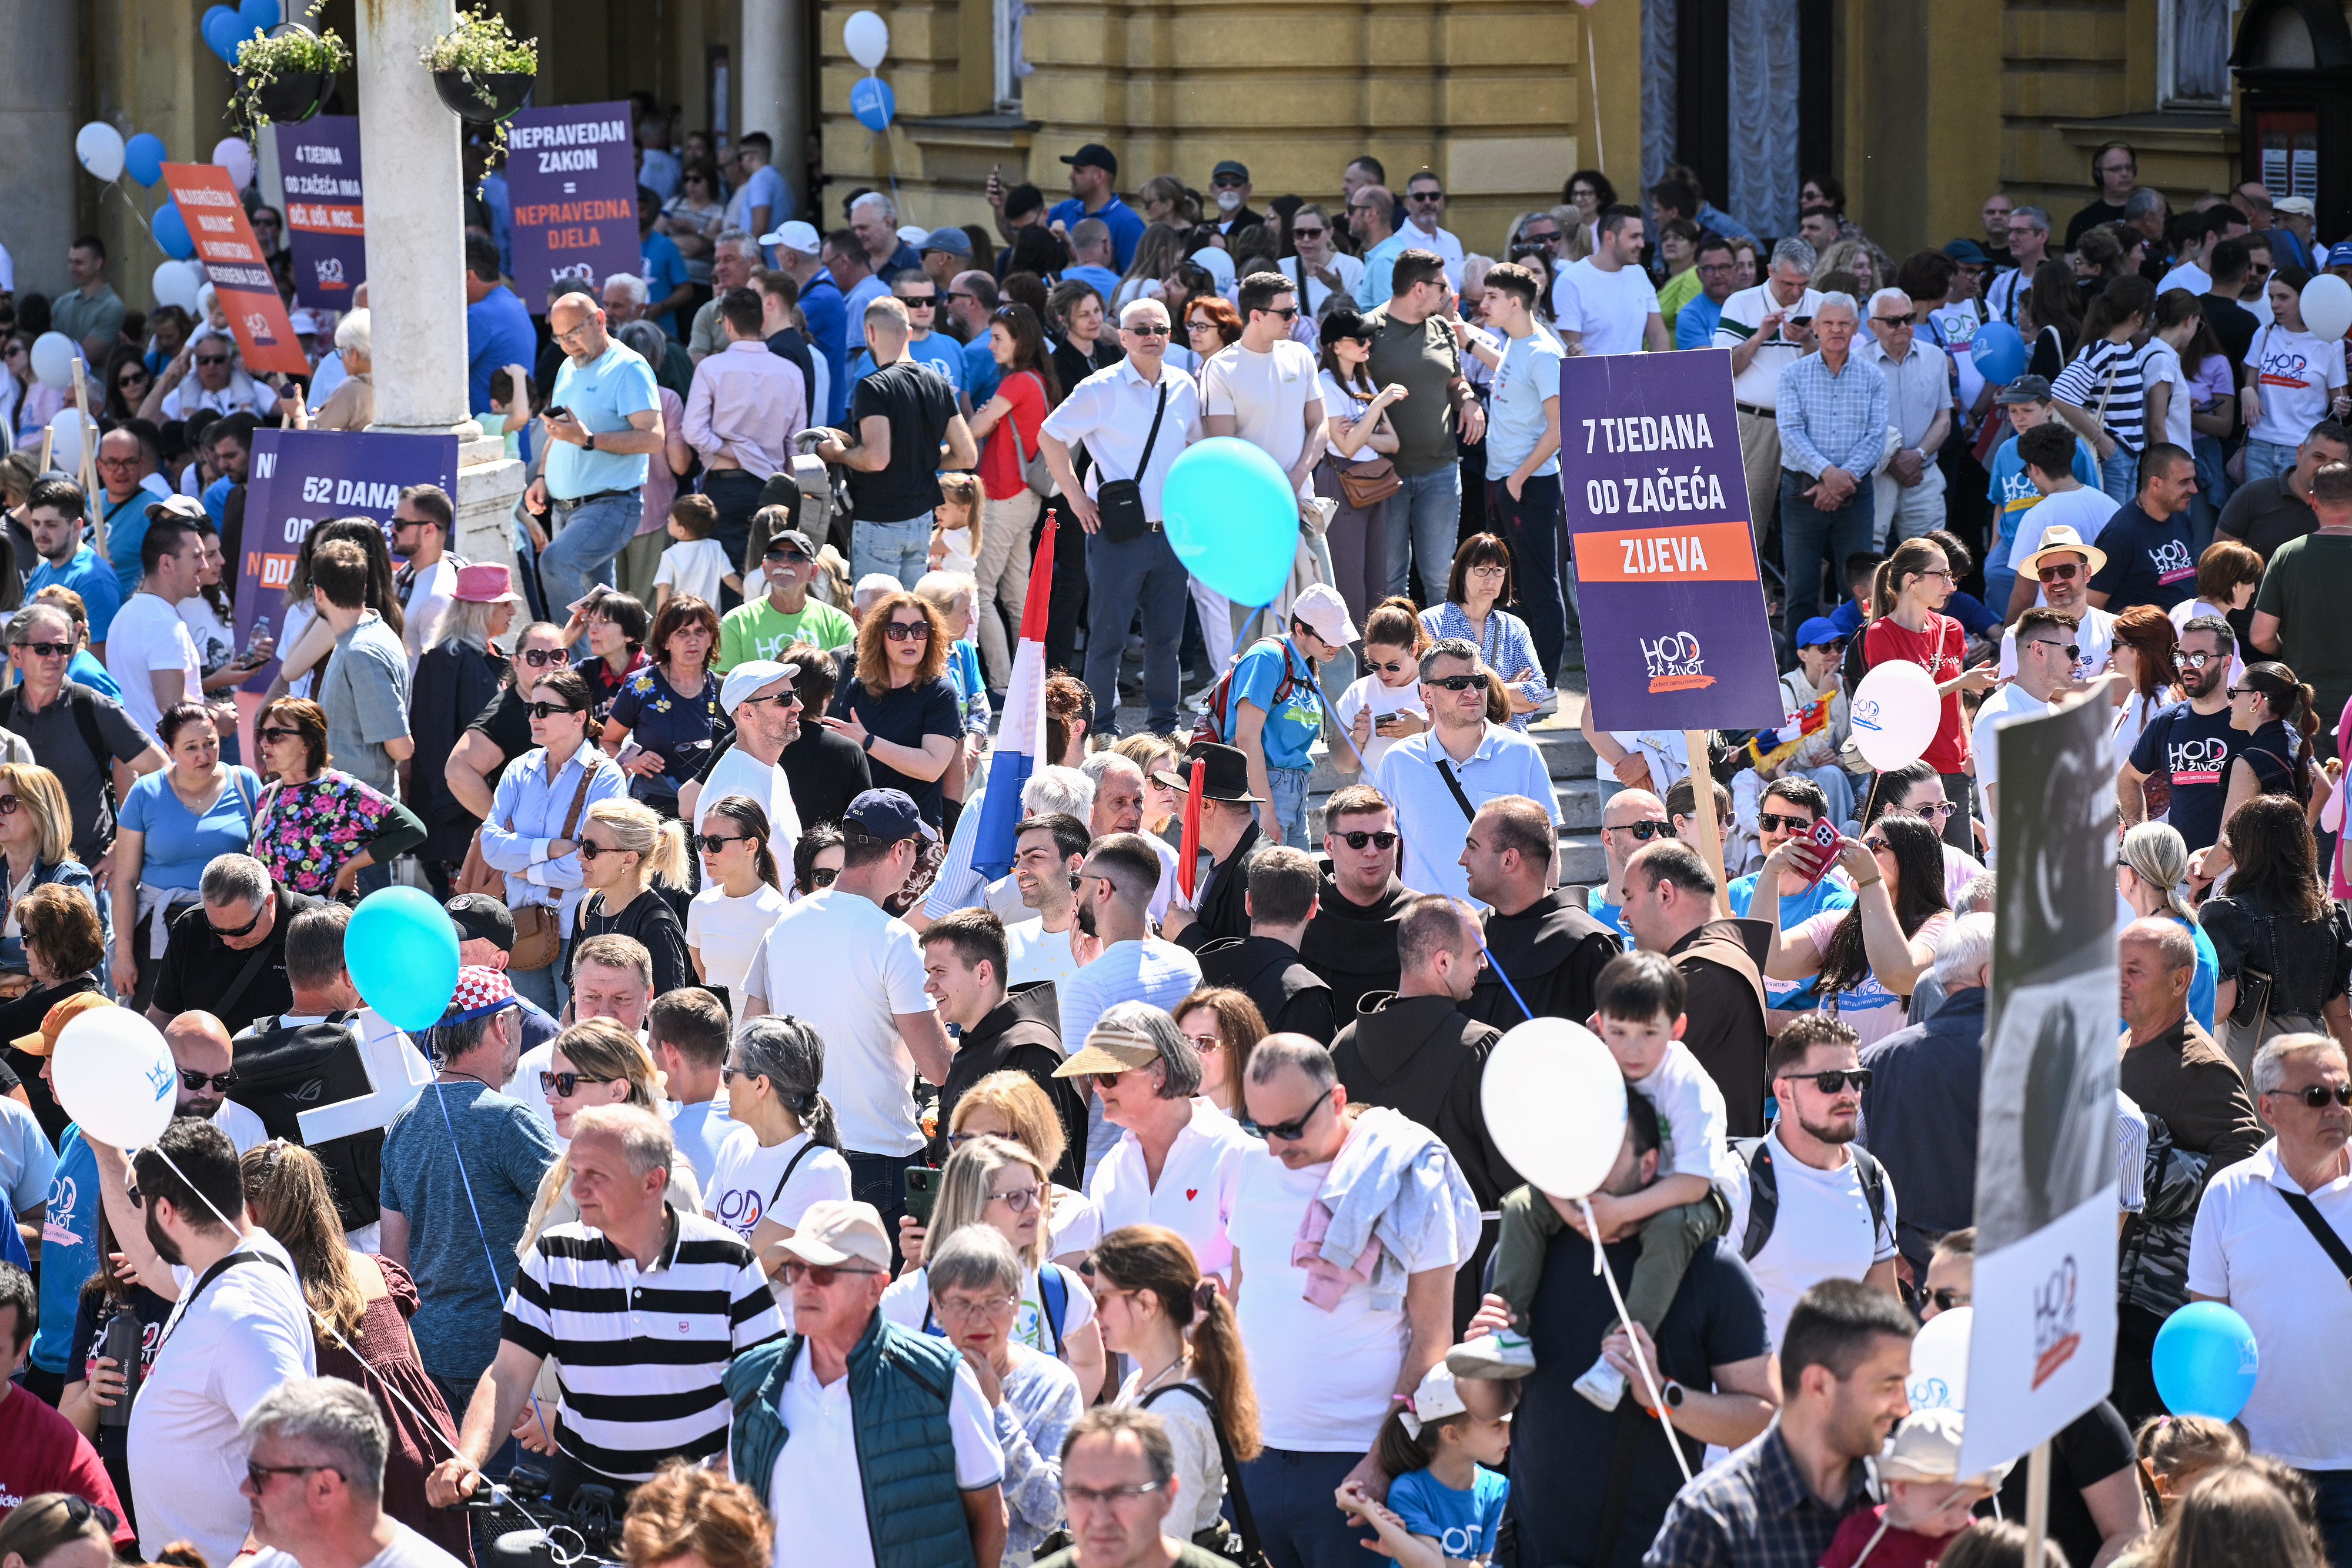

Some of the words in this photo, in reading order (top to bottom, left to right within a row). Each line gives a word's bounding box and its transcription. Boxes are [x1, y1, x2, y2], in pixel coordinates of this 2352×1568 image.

[509, 119, 626, 149] NEPRAVEDAN
[538, 148, 599, 173] ZAKON
[285, 175, 300, 194] OD
[515, 198, 632, 227] NEPRAVEDNA
[547, 226, 601, 250] DJELA
[2262, 352, 2307, 373] HOD
[1582, 419, 1596, 454] 7
[1601, 413, 1714, 453] TJEDANA
[303, 476, 333, 504] 52
[336, 479, 399, 510] DANA
[1587, 480, 1620, 514] OD
[1623, 466, 1726, 513] ZAČEĆA
[2002, 472, 2035, 495] HO
[1619, 536, 1708, 574] ZIJEVA
[2149, 539, 2188, 567] HOD
[1640, 631, 1700, 667] HOD
[1647, 661, 1666, 677] ZA
[1668, 660, 1705, 676] ŽIVOT
[1853, 696, 1879, 717] HOD
[2169, 737, 2228, 764] HOD
[2169, 760, 2185, 773] ZA
[1861, 997, 1885, 1005] HRVATSKU
